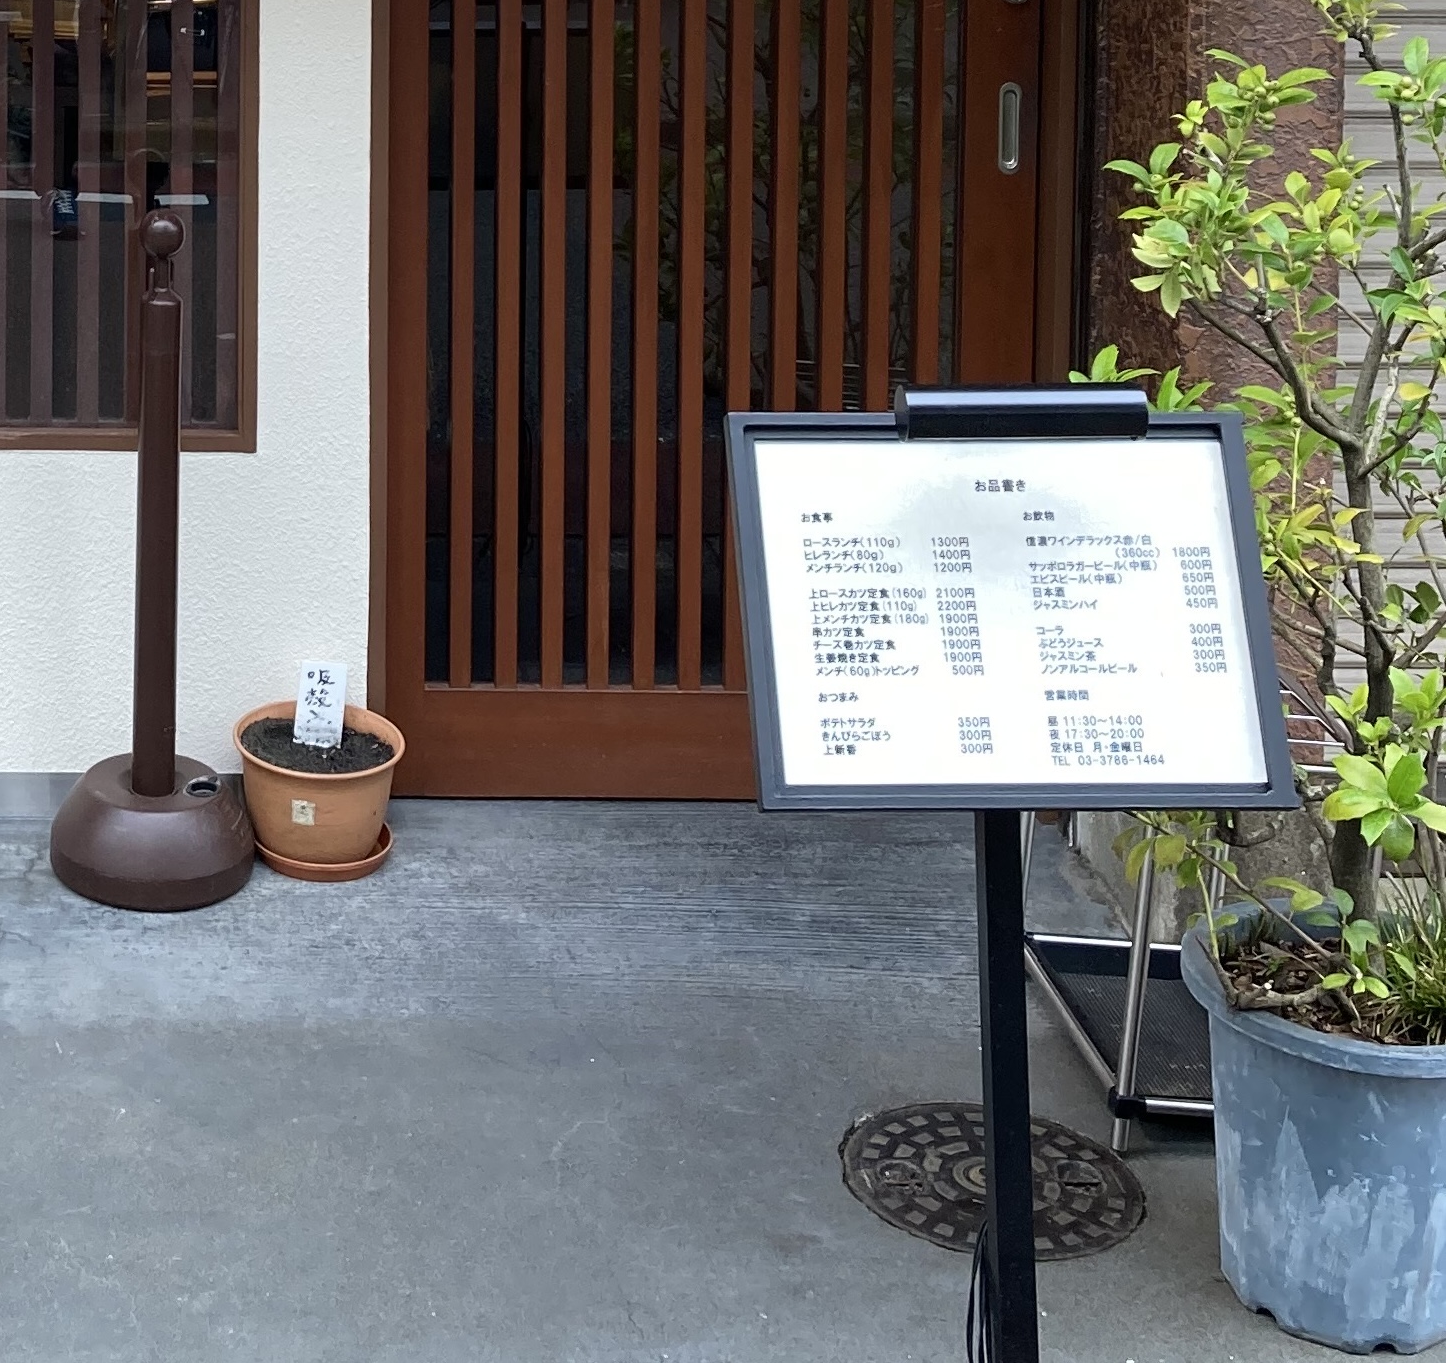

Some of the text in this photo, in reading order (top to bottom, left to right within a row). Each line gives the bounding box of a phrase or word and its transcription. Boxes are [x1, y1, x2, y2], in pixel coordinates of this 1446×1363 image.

[974, 479, 1025, 492] お品書き
[1022, 511, 1054, 521] お飲物
[803, 537, 969, 548] ロースランチ(110g) 1300円
[804, 550, 970, 561] ヒレランチ(80g) 1400円
[1171, 547, 1210, 557] 1800円
[806, 562, 972, 573] メンチランチ(120g) 1200円
[1180, 560, 1212, 570] 600円
[1181, 572, 1214, 582] 650円
[808, 588, 974, 599] 上ロースカツ定食(160g) 2100円
[1032, 585, 1216, 597] 日本酒 500円
[810, 601, 976, 612] 上ヒレカツ定食(110g) 2200円
[1033, 598, 1218, 610] ジャスミンハイ 450円
[939, 613, 978, 624] 1900円
[940, 626, 979, 637] 1900円
[1035, 624, 1221, 635] コーラ 300円
[941, 639, 980, 649] 1900円
[1038, 636, 1223, 649] ぶどうジュース 400円
[943, 652, 982, 662] 1900円
[1039, 649, 1225, 661] ジャスミン茶 300円
[952, 665, 984, 675] 500円
[1041, 662, 1227, 674] ノンアルコールビール 350円
[818, 692, 858, 702] おつまみ
[1044, 690, 1089, 701] 営業時間
[820, 717, 990, 728] ポテトサラダ 350円
[959, 730, 991, 741] 300円
[1048, 729, 1060, 739] 夜
[960, 743, 993, 753] 300円
[1050, 742, 1083, 753] 定休日
[1051, 755, 1164, 766] TEL 03-3786-1464
